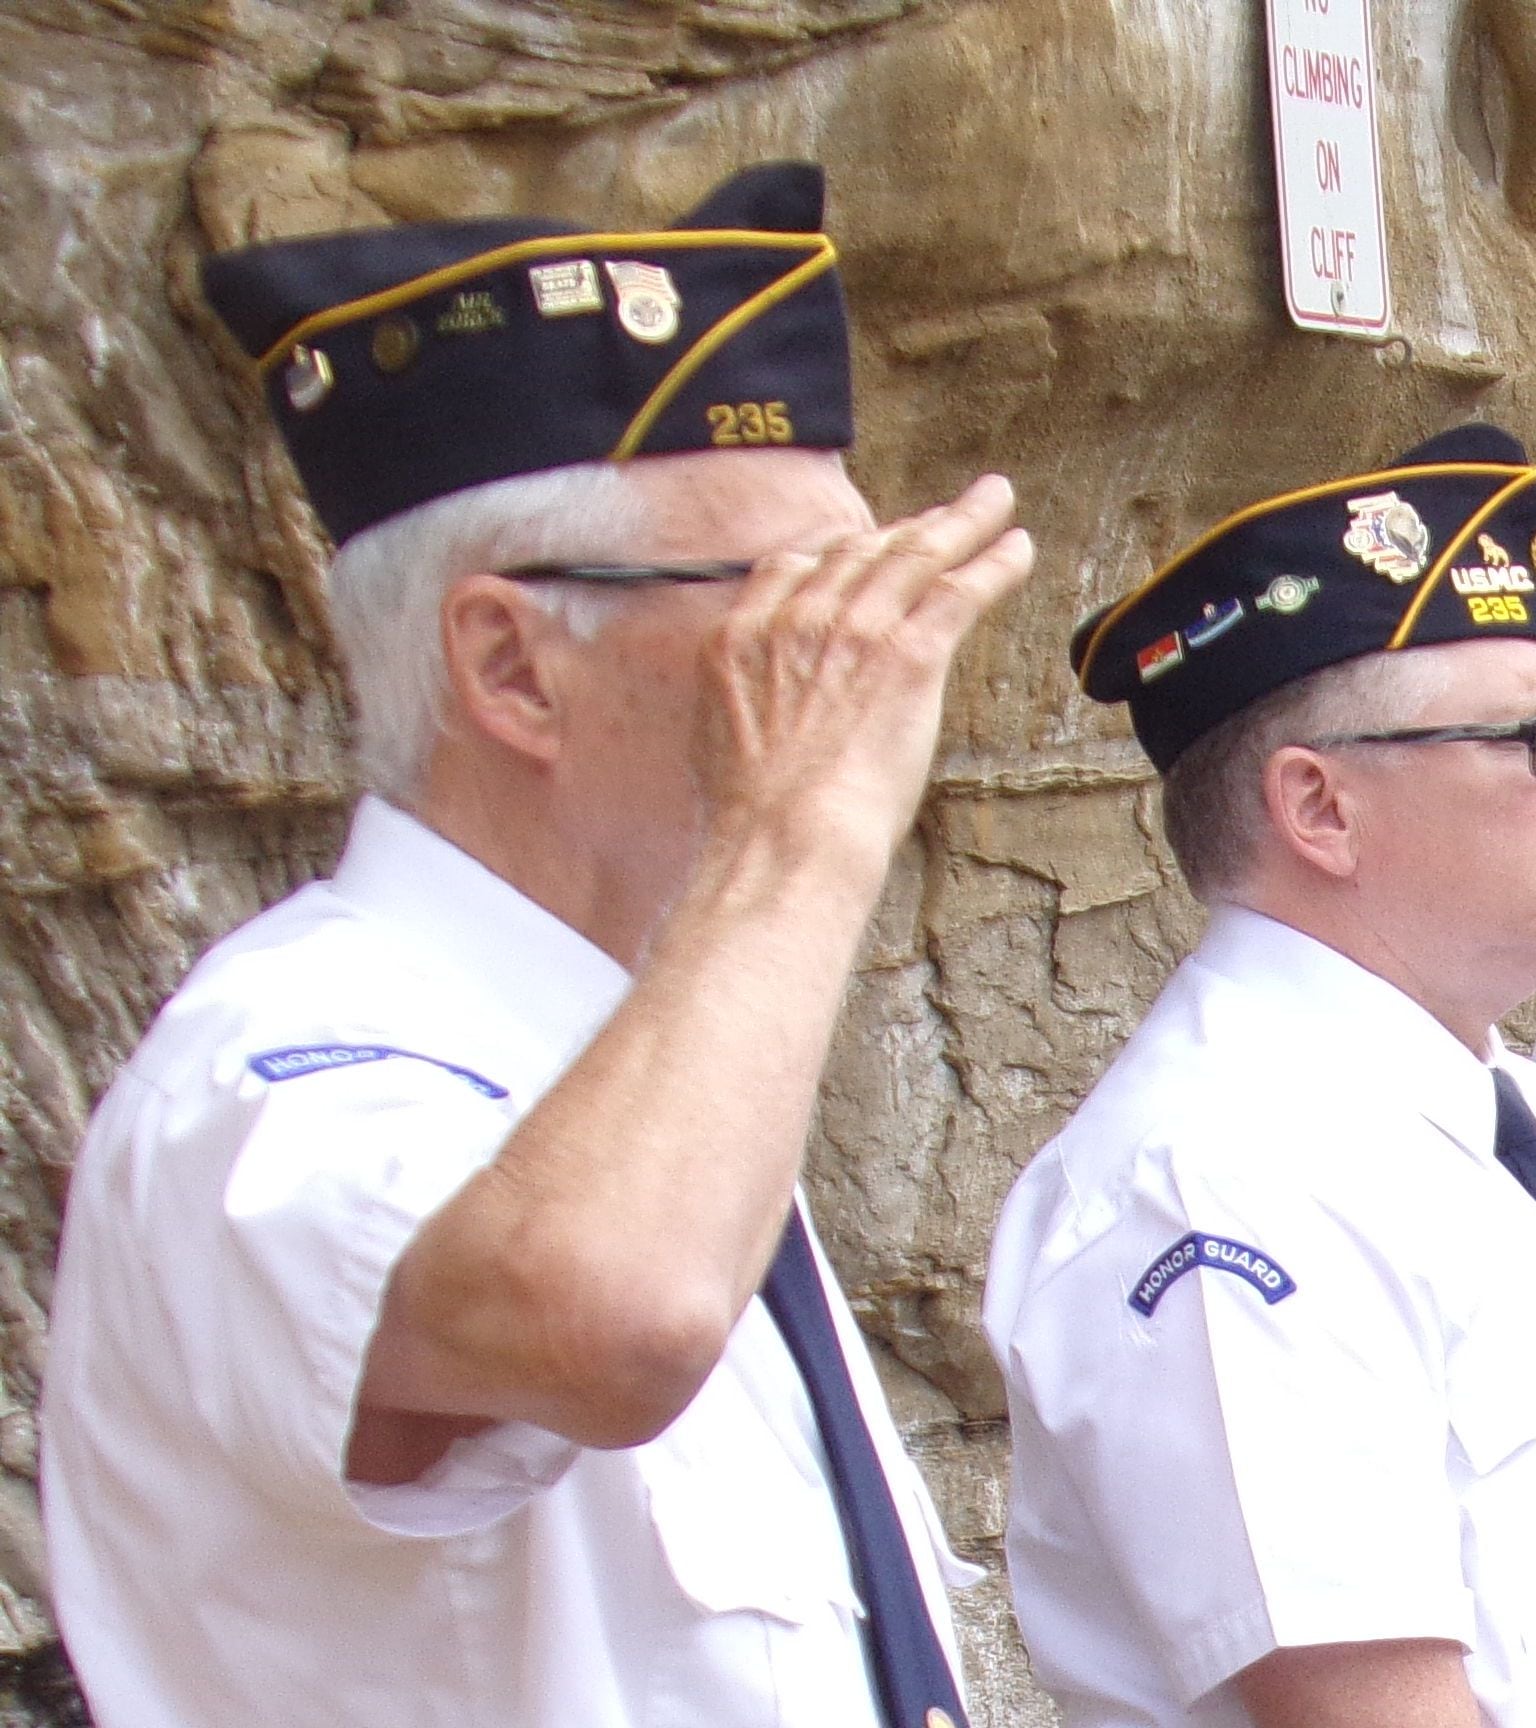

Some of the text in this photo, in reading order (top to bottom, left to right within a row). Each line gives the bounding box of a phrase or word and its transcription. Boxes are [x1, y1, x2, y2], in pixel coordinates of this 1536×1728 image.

[1283, 45, 1363, 109] CLIMBING
[1316, 140, 1342, 192] ON
[1311, 226, 1355, 282] CLIFF
[706, 401, 793, 445] 235
[1450, 565, 1534, 593] USMC
[1467, 595, 1528, 623] 235
[1139, 1240, 1281, 1303] HONOR GUARD
